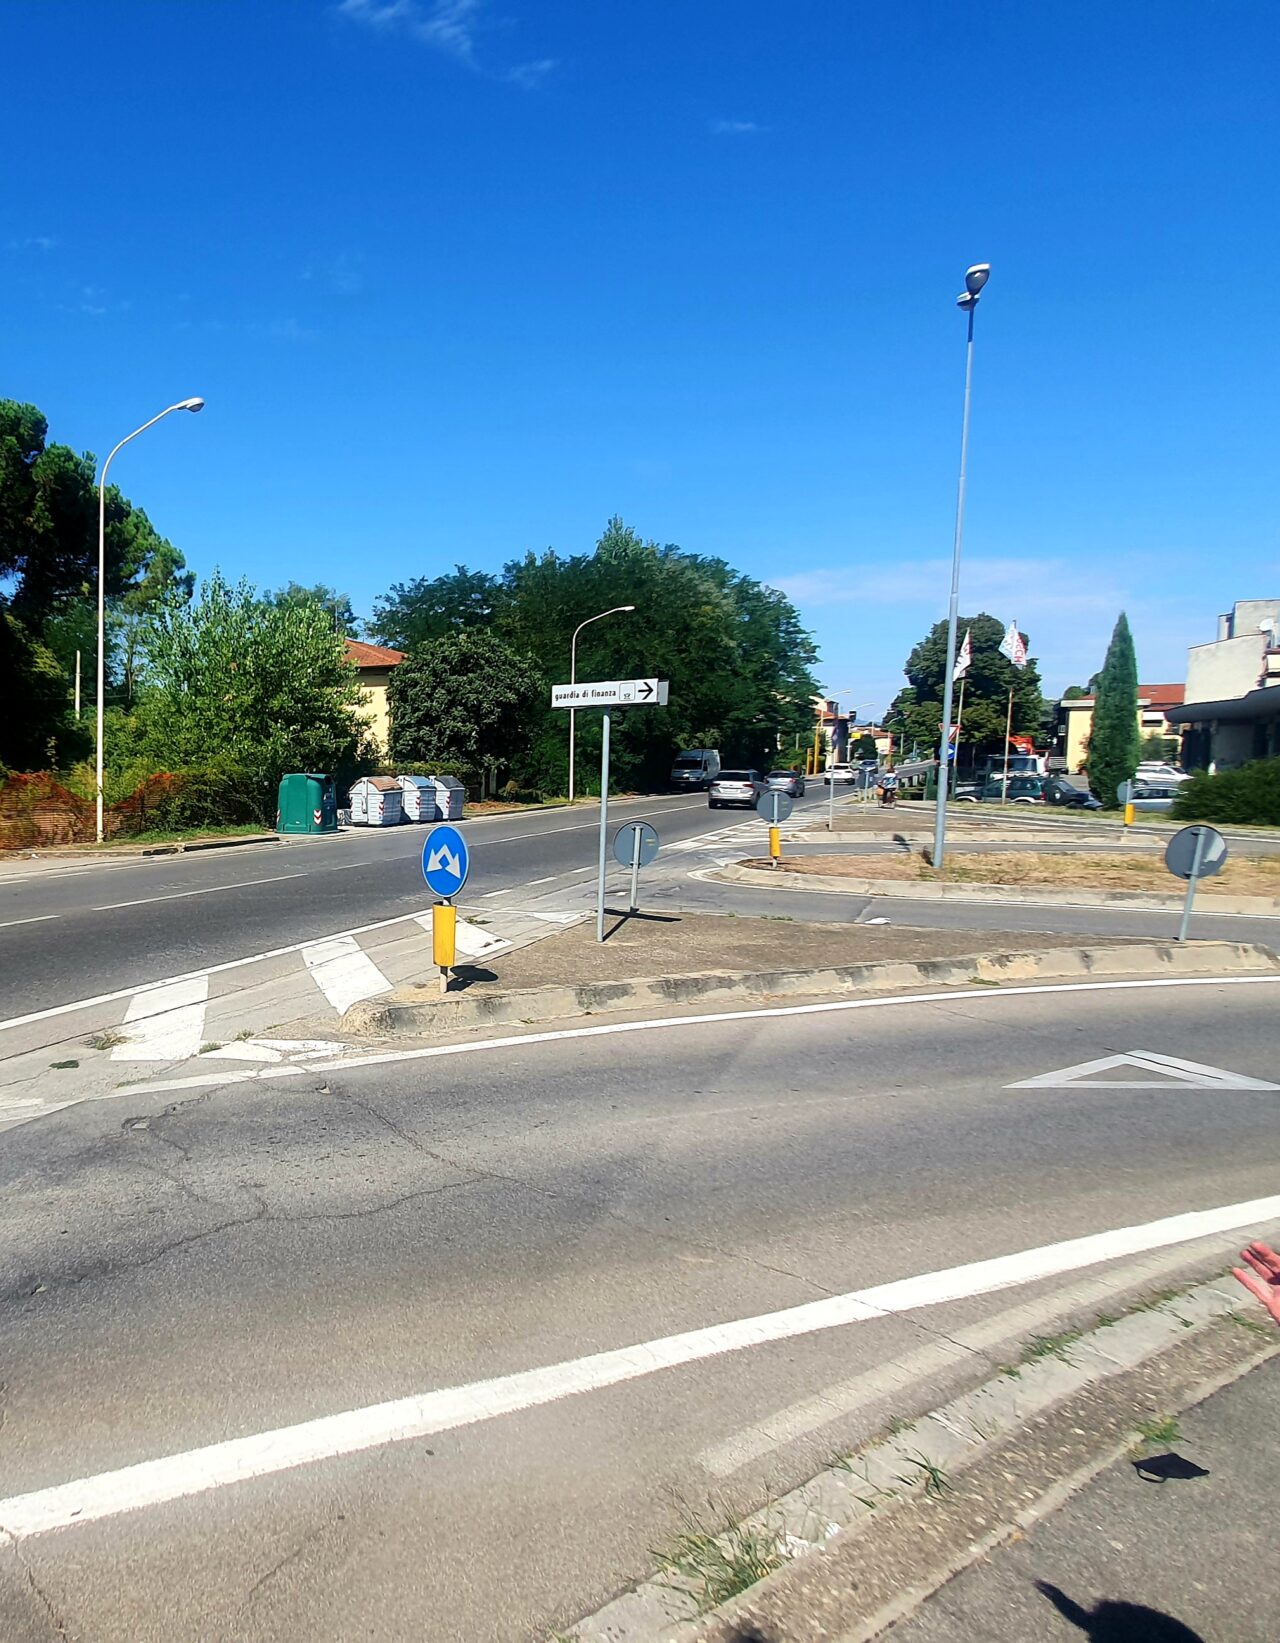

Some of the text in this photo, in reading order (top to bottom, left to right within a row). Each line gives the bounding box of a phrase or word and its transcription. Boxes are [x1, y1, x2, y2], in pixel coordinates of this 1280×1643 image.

[555, 689, 616, 702] guardia di finanza
